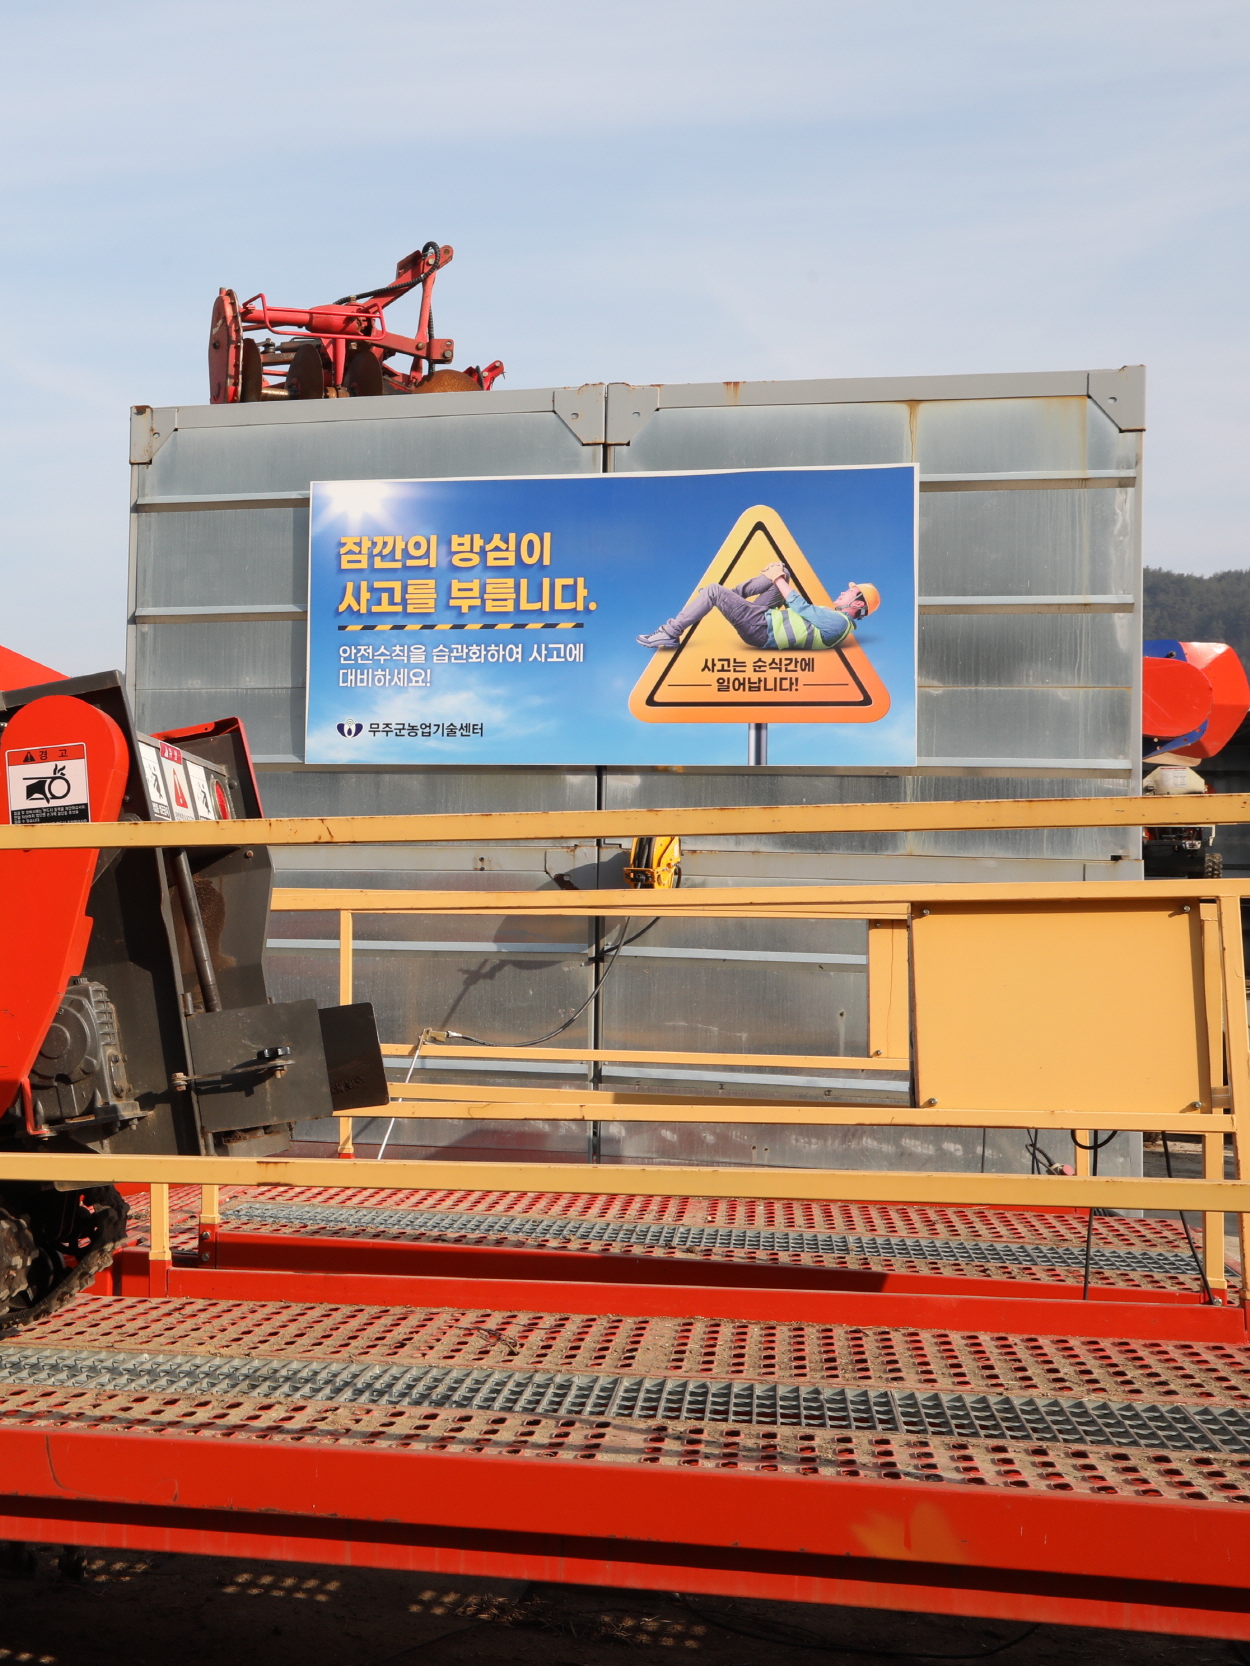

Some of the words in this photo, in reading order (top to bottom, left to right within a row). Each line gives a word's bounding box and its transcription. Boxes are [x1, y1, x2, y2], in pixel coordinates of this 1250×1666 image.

[339, 534, 438, 569] 잠깐의
[450, 532, 551, 567] 방심이
[338, 579, 437, 614] 사고를
[449, 577, 597, 613] 부릅니다.
[339, 645, 426, 664] 안전수칙을
[432, 643, 522, 663] 습관화하여
[528, 643, 584, 662] 사고에
[701, 658, 747, 673] 사고는
[752, 657, 815, 673] 순식간에
[339, 668, 431, 687] 대비하세요!
[716, 677, 799, 692] 일어납니다!
[368, 722, 484, 737] 무주군농업기술센터
